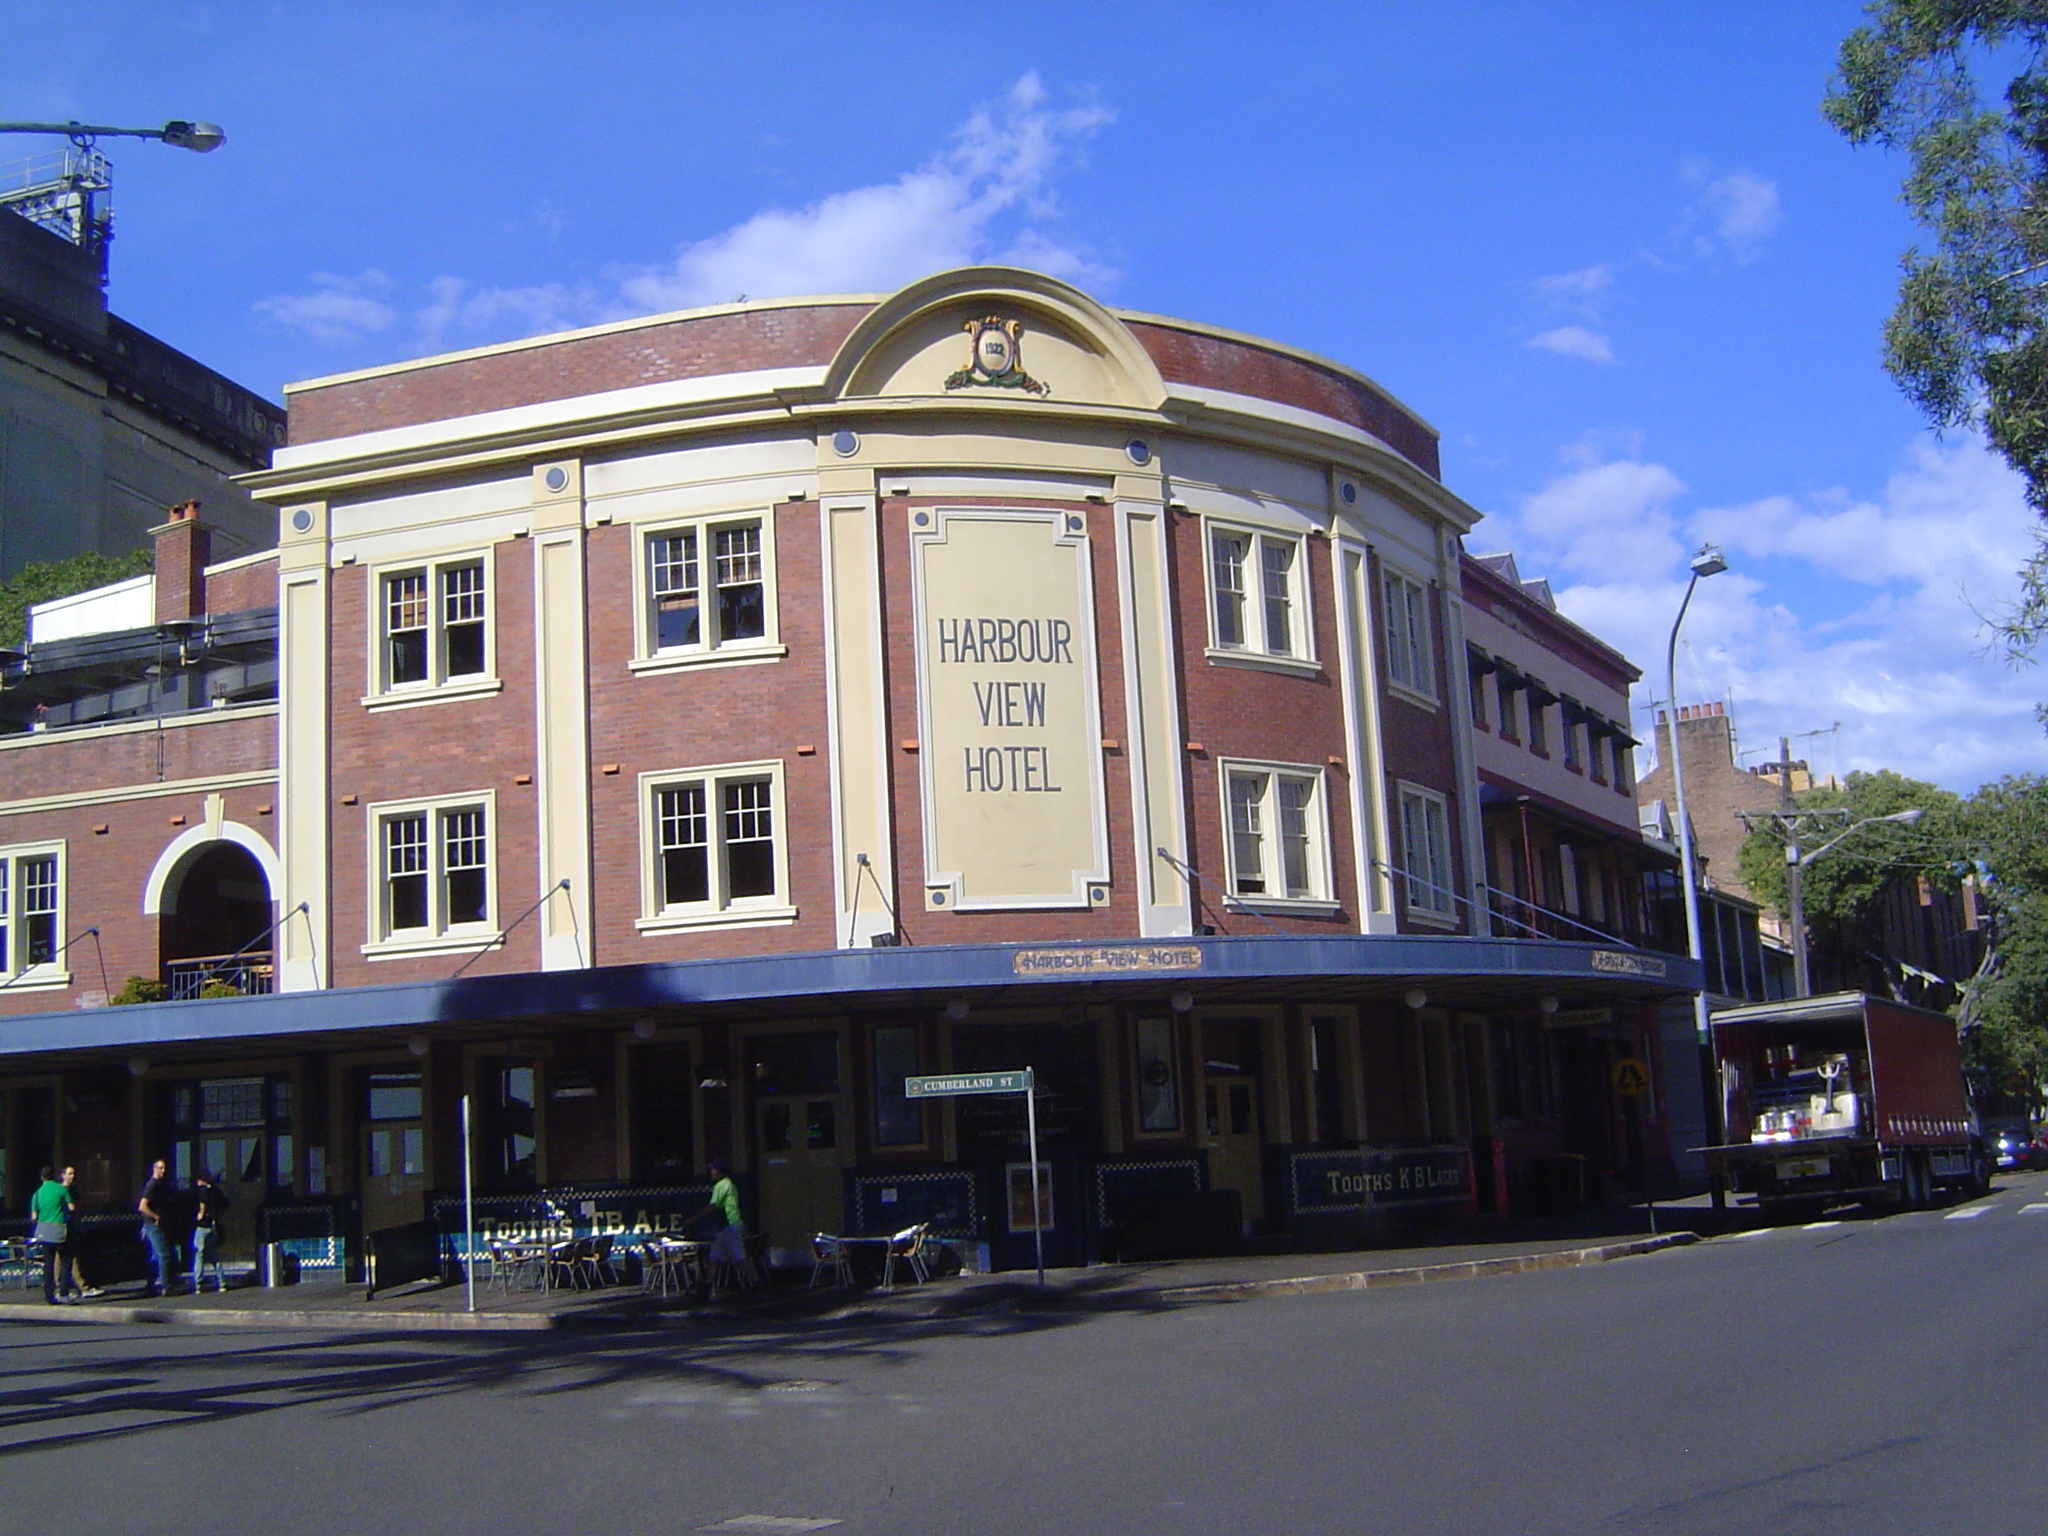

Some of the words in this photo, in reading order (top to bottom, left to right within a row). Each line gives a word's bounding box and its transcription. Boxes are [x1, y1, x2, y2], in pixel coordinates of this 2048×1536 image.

[938, 617, 1073, 664] HARBOUR
[973, 681, 1046, 728] VIEW
[965, 745, 1062, 793] HOTEL
[1022, 954, 1094, 970] HARBOUR
[1101, 951, 1139, 967] VIEW
[1148, 950, 1197, 965] HOTEL
[924, 1077, 993, 1091] CUMBERLAND
[1000, 1077, 1013, 1087] ST
